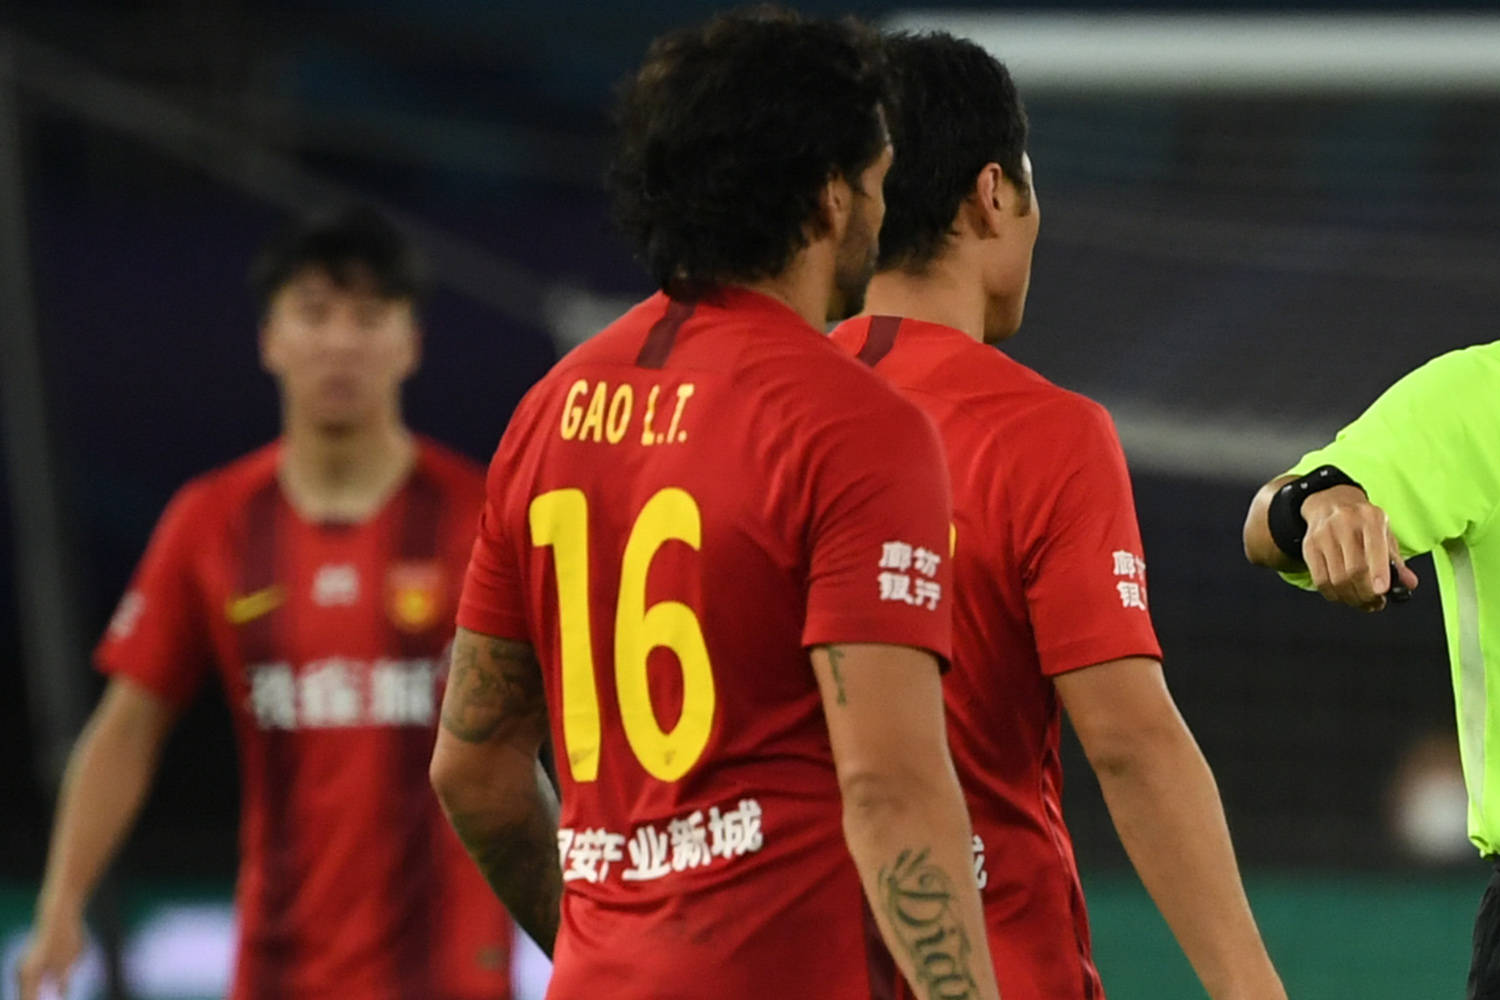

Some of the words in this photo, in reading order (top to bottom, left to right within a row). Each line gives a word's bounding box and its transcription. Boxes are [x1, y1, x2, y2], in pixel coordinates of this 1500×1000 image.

[561, 379, 634, 444] GAO
[879, 540, 941, 578] 廊坊
[878, 571, 942, 611] 银行
[529, 487, 716, 782] 16
